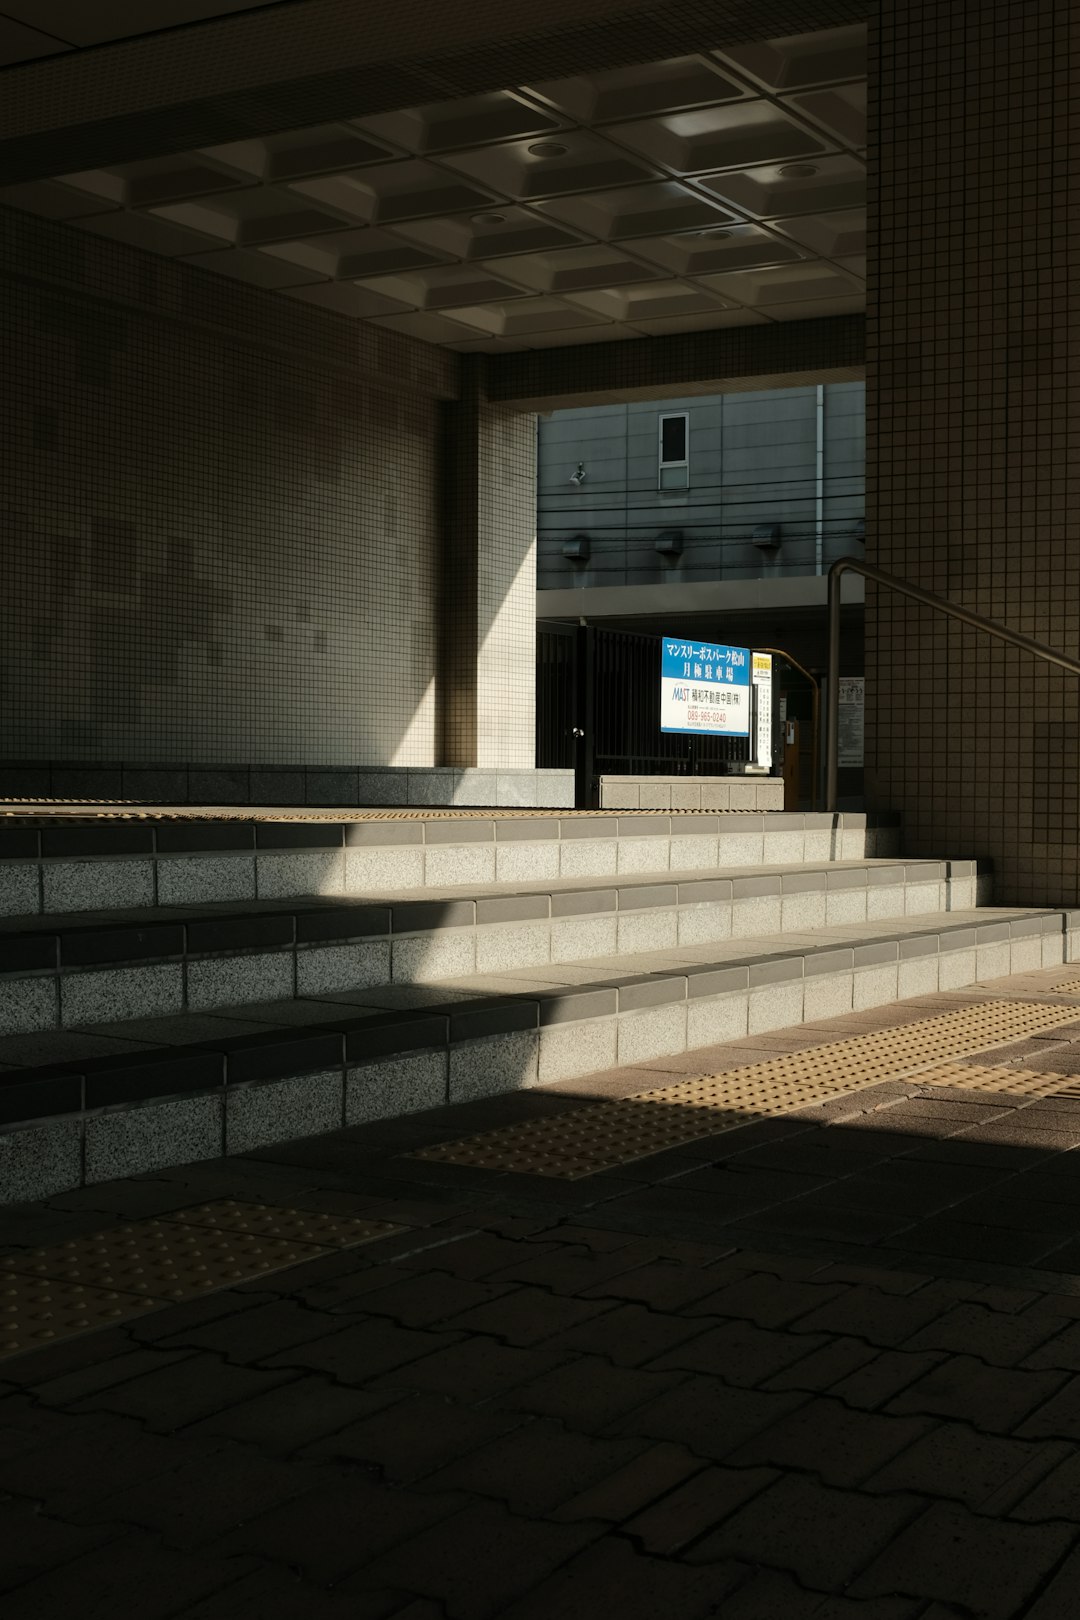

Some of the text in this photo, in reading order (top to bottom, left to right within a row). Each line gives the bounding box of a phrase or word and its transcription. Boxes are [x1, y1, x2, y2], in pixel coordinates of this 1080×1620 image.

[683, 662, 733, 682] 月極駐車場
[672, 688, 690, 701] MAST
